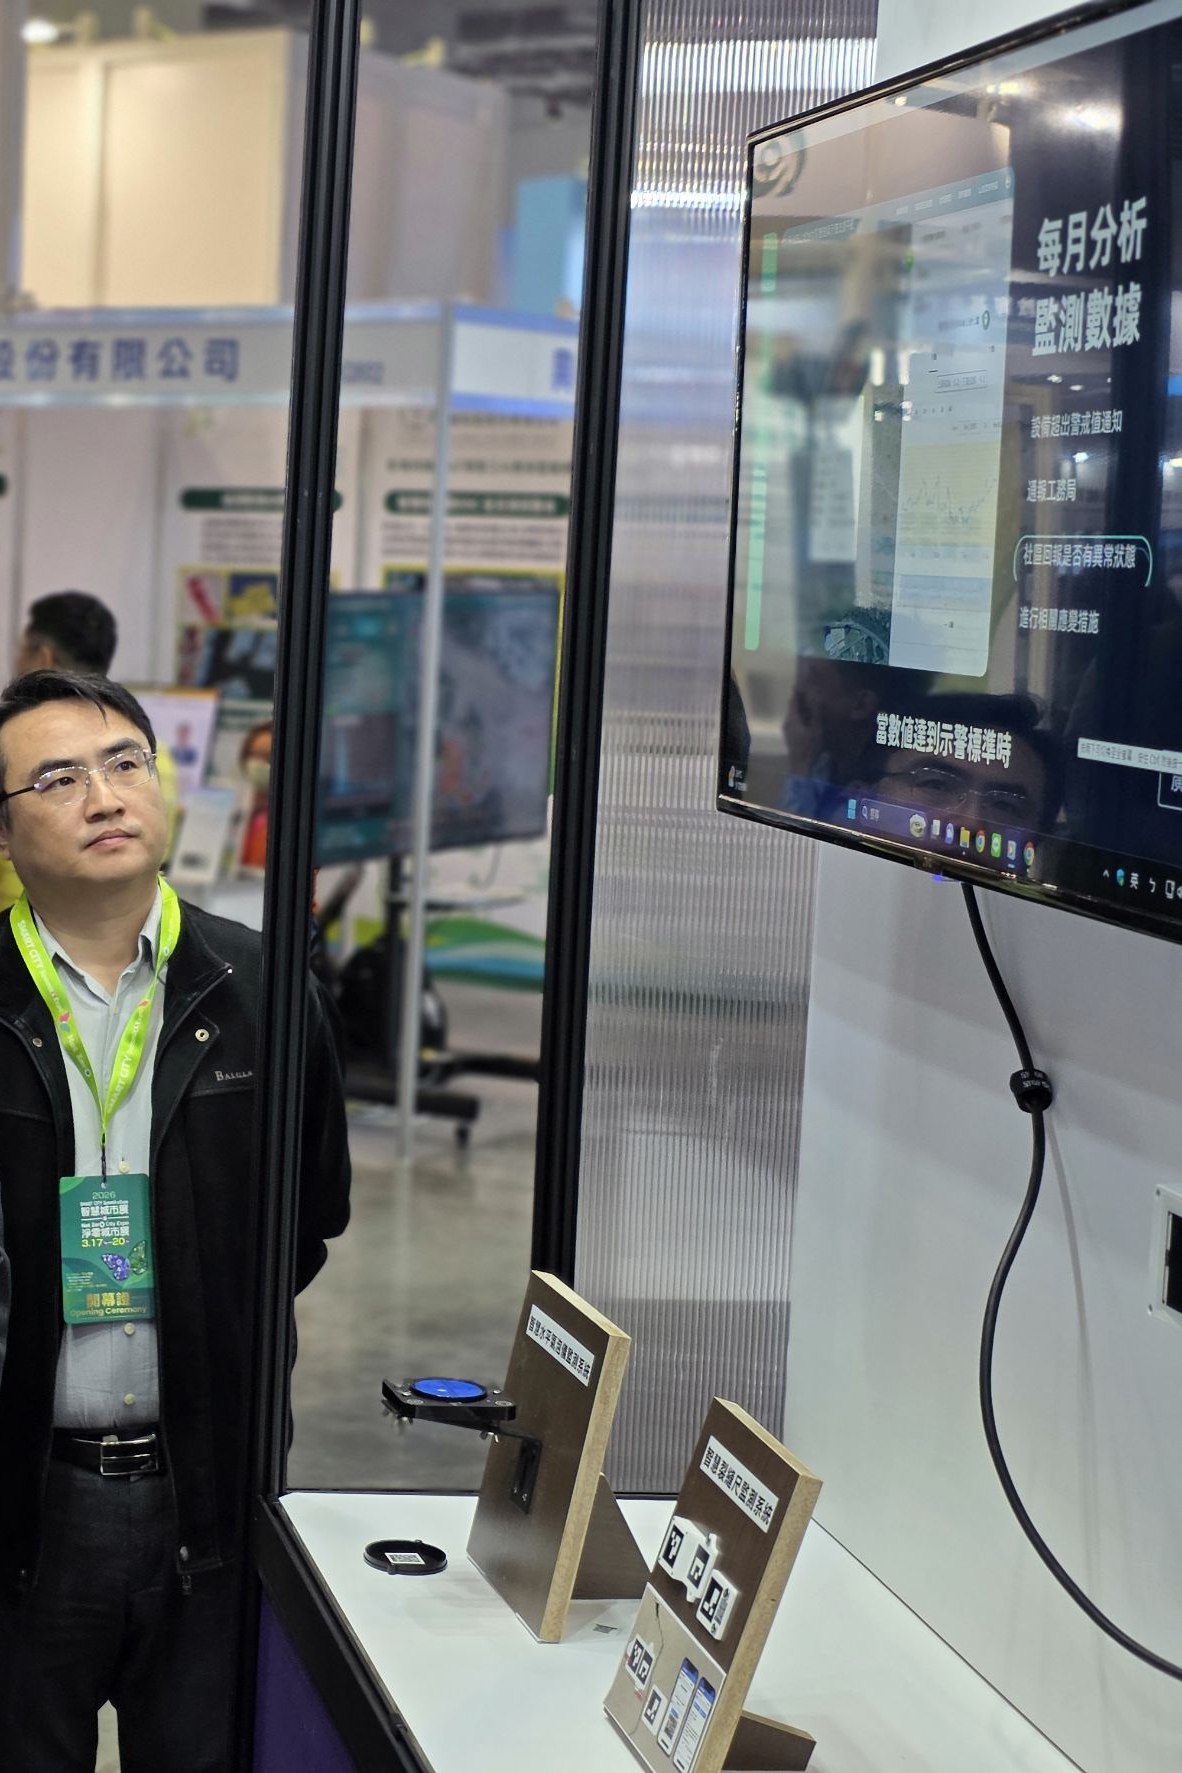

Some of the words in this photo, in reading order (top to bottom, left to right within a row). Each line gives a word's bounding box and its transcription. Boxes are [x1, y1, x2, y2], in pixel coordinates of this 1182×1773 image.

[1037, 196, 1147, 278] 每月分析
[1032, 281, 1142, 356] 監測數據
[1023, 543, 1136, 568] 社區回報是否有異常狀態
[1019, 606, 1100, 634] 進行相關應變措施
[876, 712, 1012, 769] 當數值達到示警標準時
[1130, 872, 1139, 890] 英
[29, 947, 44, 969] CITY
[120, 1055, 132, 1078] CITY
[92, 1191, 116, 1200] 2026
[70, 1308, 104, 1317] Opening
[105, 1306, 147, 1315] Ceremony
[86, 1292, 130, 1308] 開幕證
[703, 1446, 773, 1526] 智慧裂縫尺監測系統
